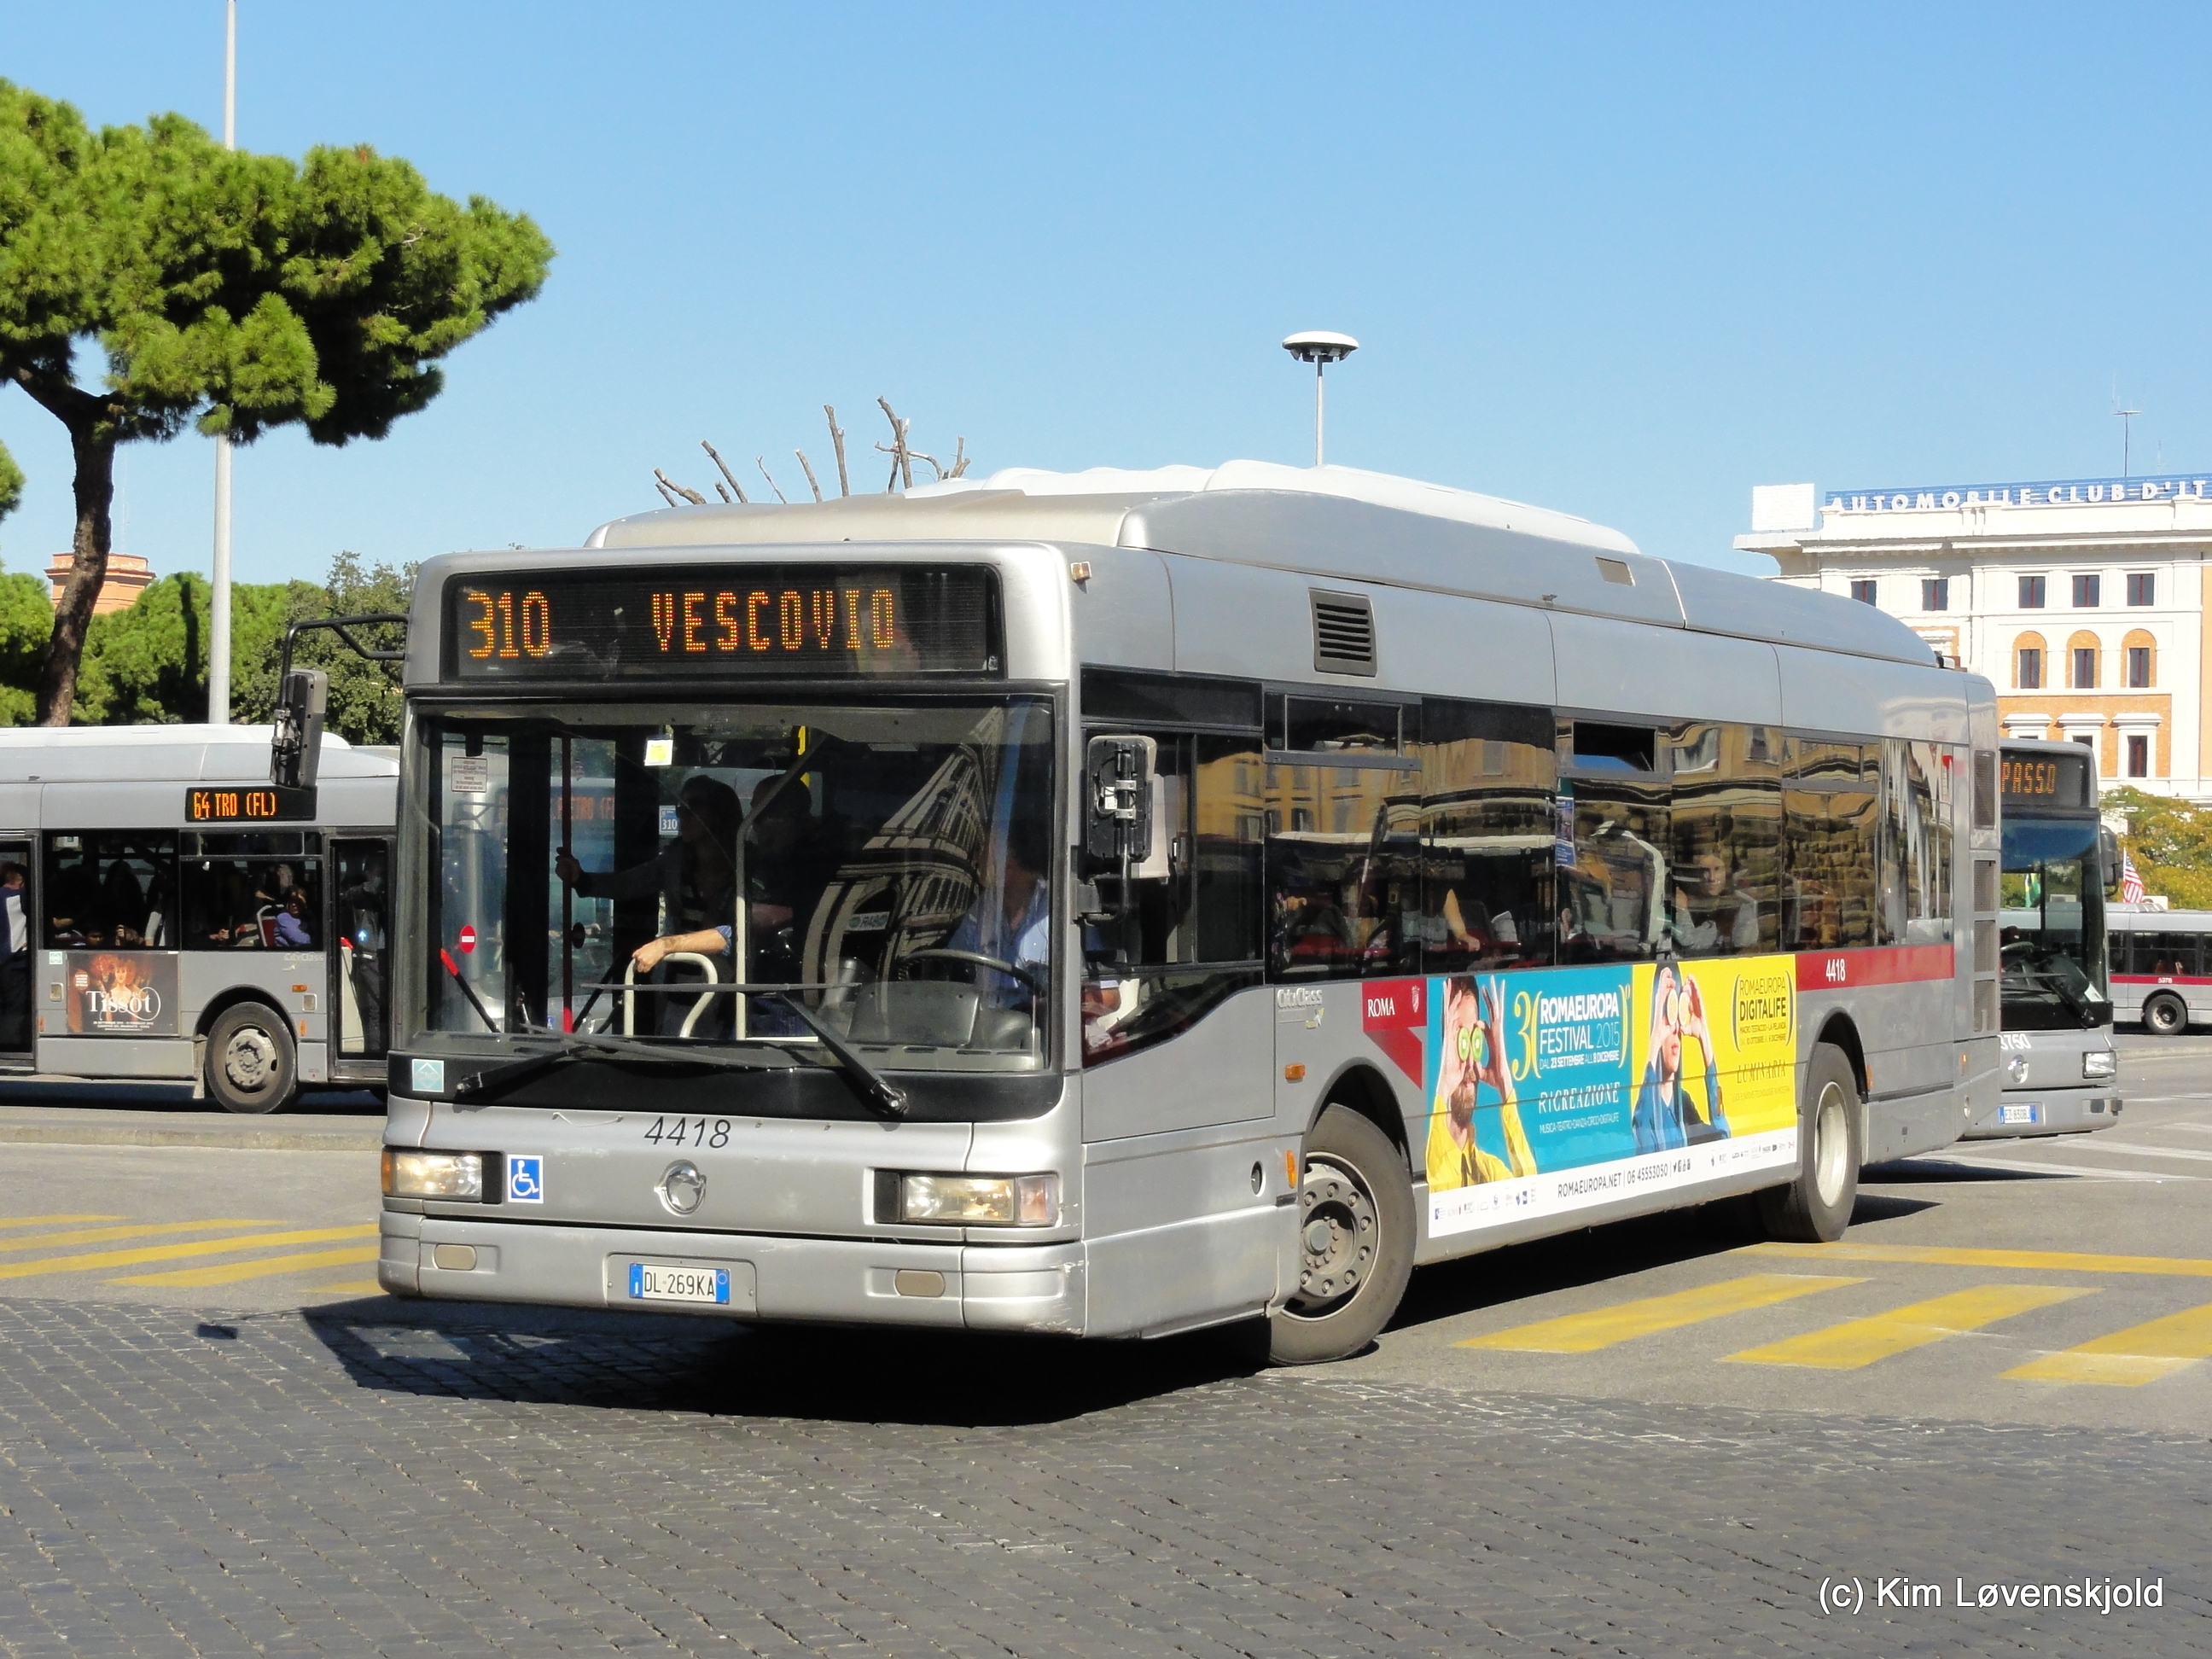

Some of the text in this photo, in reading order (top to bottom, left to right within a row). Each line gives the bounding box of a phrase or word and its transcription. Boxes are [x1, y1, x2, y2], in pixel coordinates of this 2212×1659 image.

[1831, 489, 2031, 510] AUTOMOBILE
[2047, 484, 2125, 504] CLUB
[467, 589, 894, 658] 310 VESCOVIO
[2001, 762, 2056, 794] PASSO
[194, 792, 276, 818] 64 TRO (FL)
[661, 818, 678, 830] 310
[1825, 958, 1846, 982] 4418
[1739, 976, 1786, 996] ROMAEUROPA
[85, 988, 159, 1020] Tissot
[1367, 998, 1395, 1017] ROMA
[1540, 992, 1620, 1025] ROMAEUROPA
[1739, 997, 1786, 1022] DIGITALIFE
[1540, 1022, 1621, 1055] FESTIVAL 2015
[1540, 1058, 1551, 1070] DAL
[1550, 1057, 1557, 1068] 23
[1539, 1081, 1620, 1115] RICREAZIONE
[643, 1115, 731, 1149] 4418
[1558, 1163, 1668, 1198] ROMAEUROPA.NET 06 45553050
[643, 1272, 715, 1296] DL 269KA
